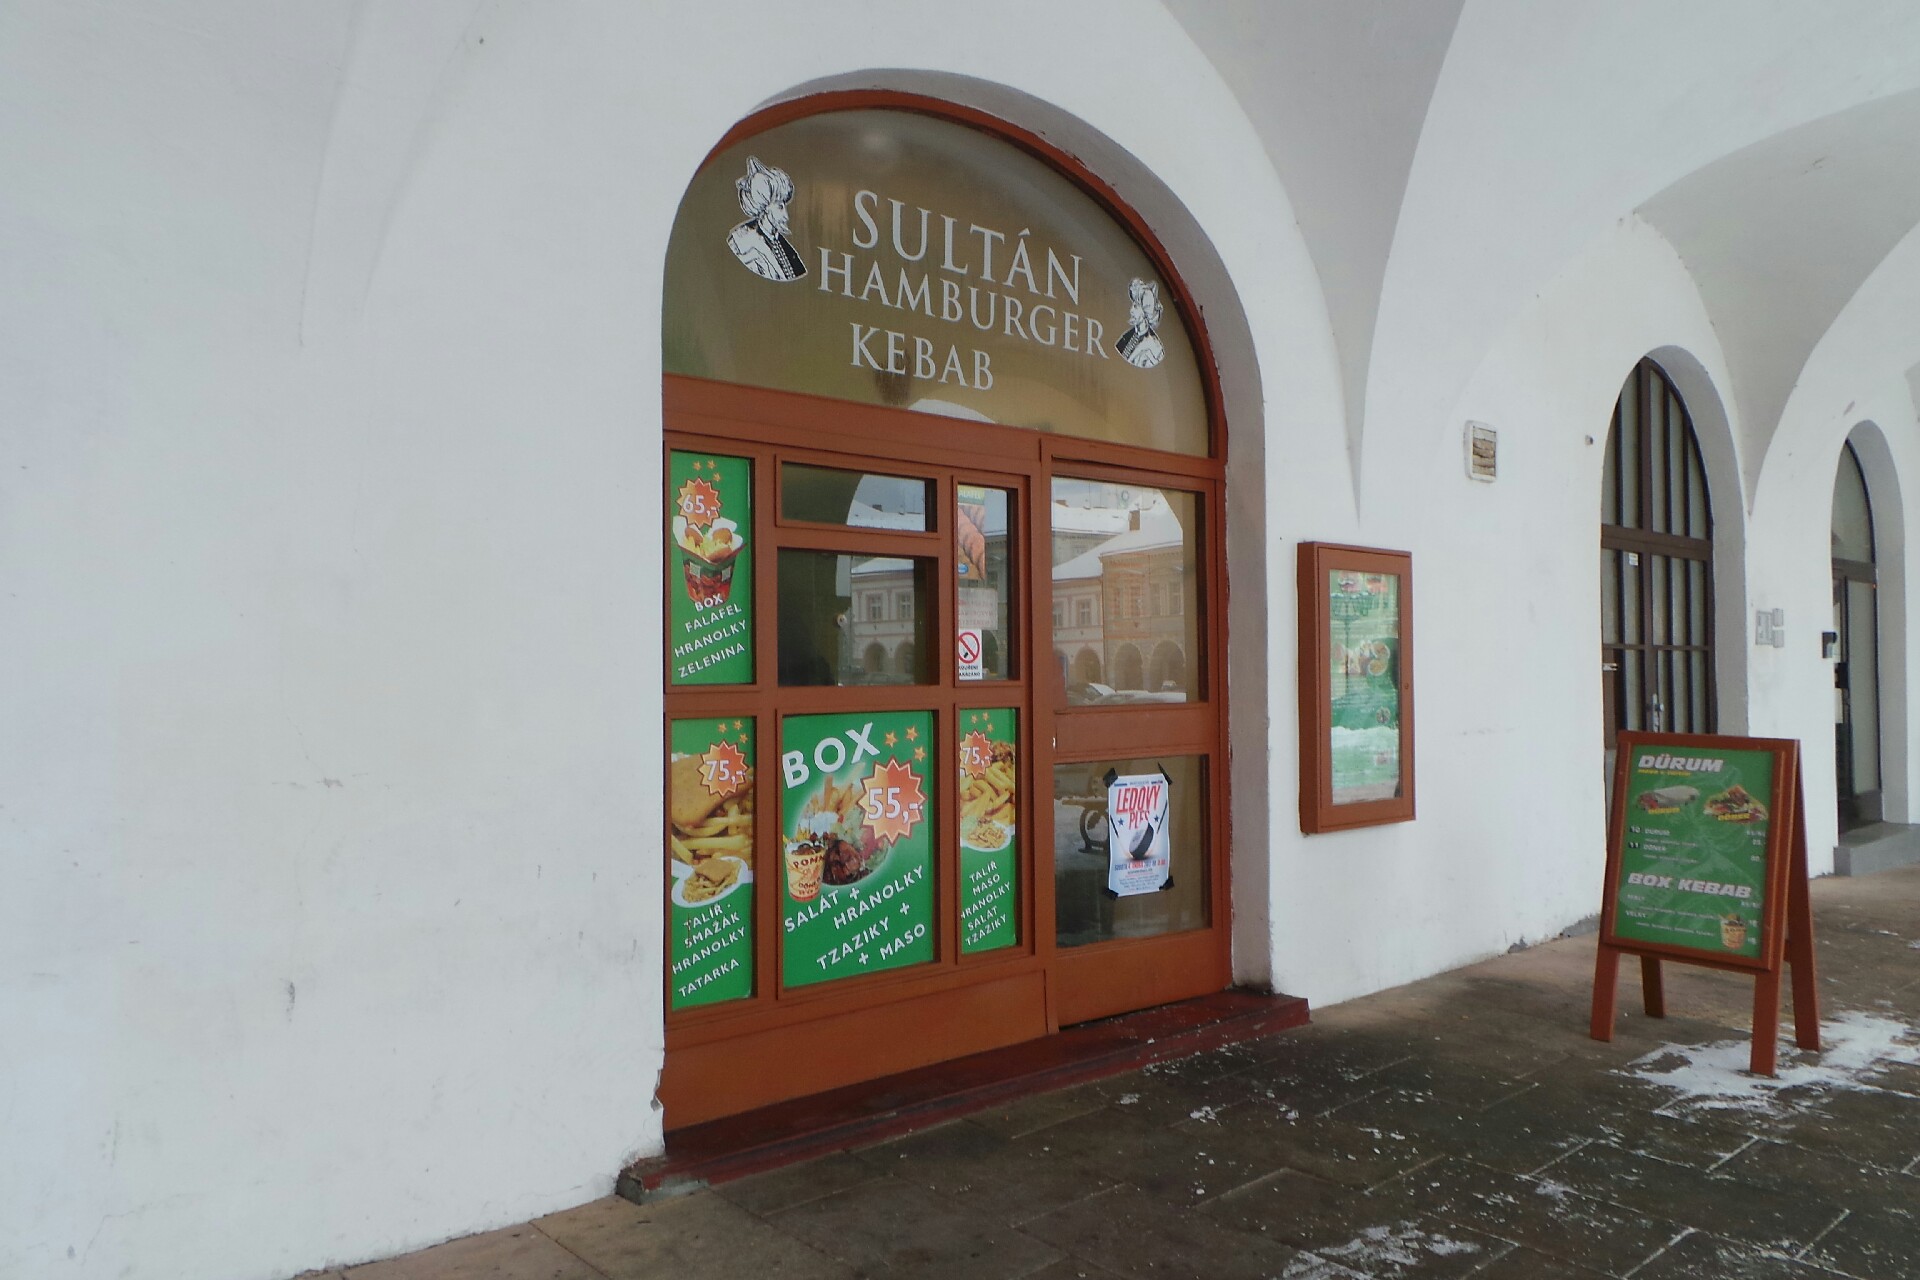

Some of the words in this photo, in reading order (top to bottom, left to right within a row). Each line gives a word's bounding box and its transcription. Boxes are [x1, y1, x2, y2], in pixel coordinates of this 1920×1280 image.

[852, 189, 1083, 305] SULTÁN
[817, 246, 1109, 360] HAMBURGER
[849, 322, 995, 392] KEBAB
[685, 603, 742, 633] FALAFEL
[695, 593, 724, 612] BOX
[674, 619, 746, 658] HRANOLKY
[678, 642, 745, 678] ZELENINA
[782, 721, 880, 789] BOX
[1638, 753, 1724, 772] DÜRUM
[833, 864, 923, 930] HRANOLKY
[972, 873, 1001, 896] MASO
[1628, 872, 1673, 888] BOX
[1678, 879, 1752, 899] KEBAB
[816, 916, 889, 970] TZAZIKY
[879, 923, 926, 961] MASO
[965, 913, 1007, 946] TZAZIKY
[672, 926, 745, 975] HRANOLKY
[678, 958, 740, 998] TATARKA
